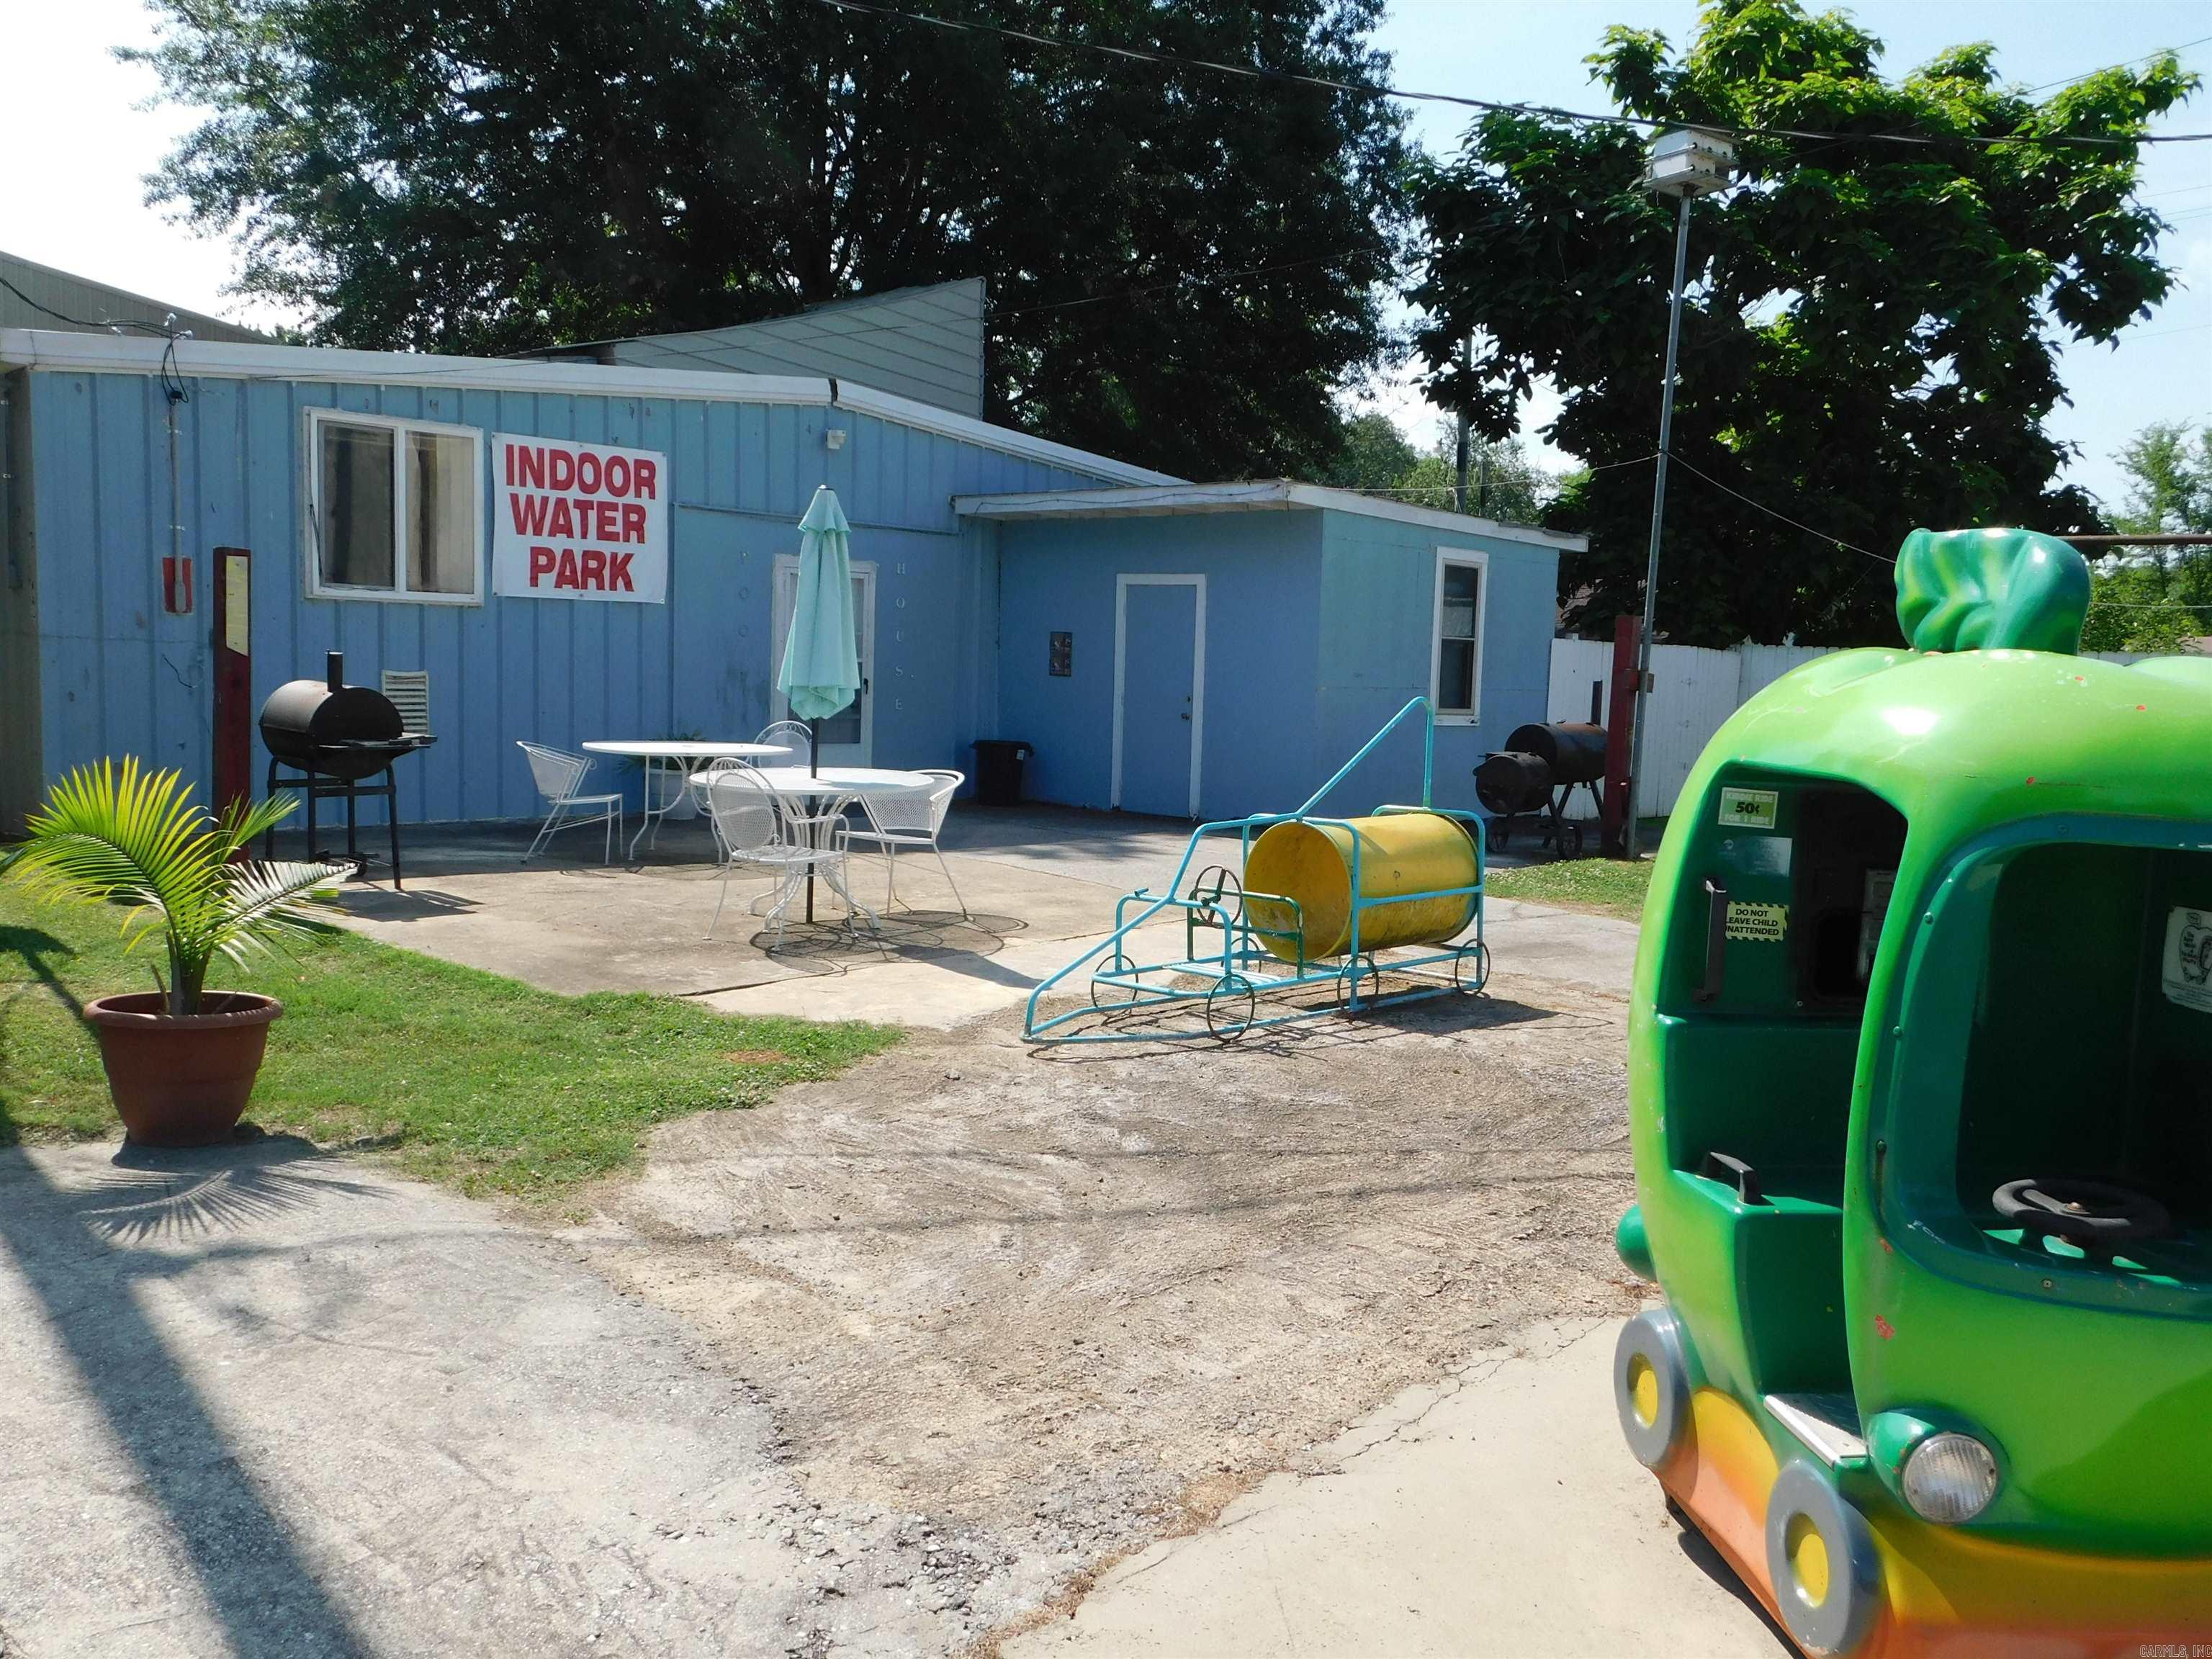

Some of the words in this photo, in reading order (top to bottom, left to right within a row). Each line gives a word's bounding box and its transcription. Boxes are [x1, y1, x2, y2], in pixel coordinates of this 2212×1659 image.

[505, 444, 656, 500] INDOOR
[509, 493, 646, 544] WATER
[530, 546, 634, 592] PARK
[894, 562, 905, 709] HOUSE
[1755, 794, 1774, 803] RIDE
[1726, 925, 1779, 935] NATTENDED
